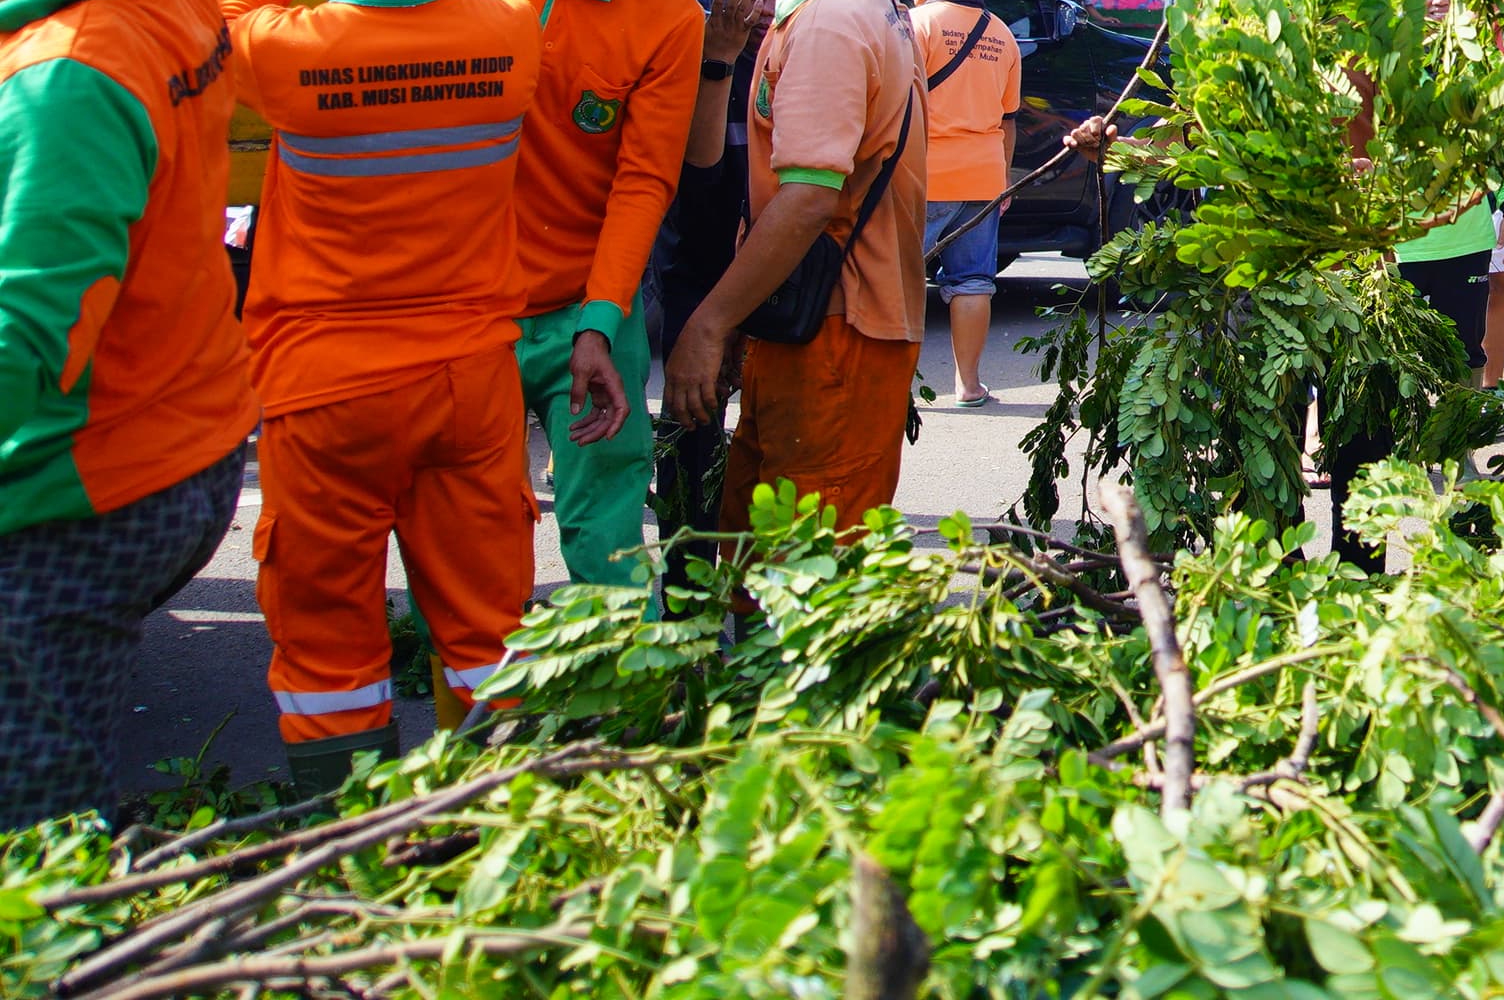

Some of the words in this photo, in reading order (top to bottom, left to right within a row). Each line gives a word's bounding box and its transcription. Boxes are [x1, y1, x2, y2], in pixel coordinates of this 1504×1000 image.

[942, 30, 965, 40] Bidang
[945, 39, 958, 47] dan
[980, 54, 999, 62] Muba
[299, 67, 354, 87] DINAS
[358, 59, 467, 84] LINGKUNGAN
[471, 56, 514, 75] HIDUP
[317, 92, 358, 111] KAB.
[362, 86, 407, 107] MUSI
[411, 80, 504, 103] BANYUASIN
